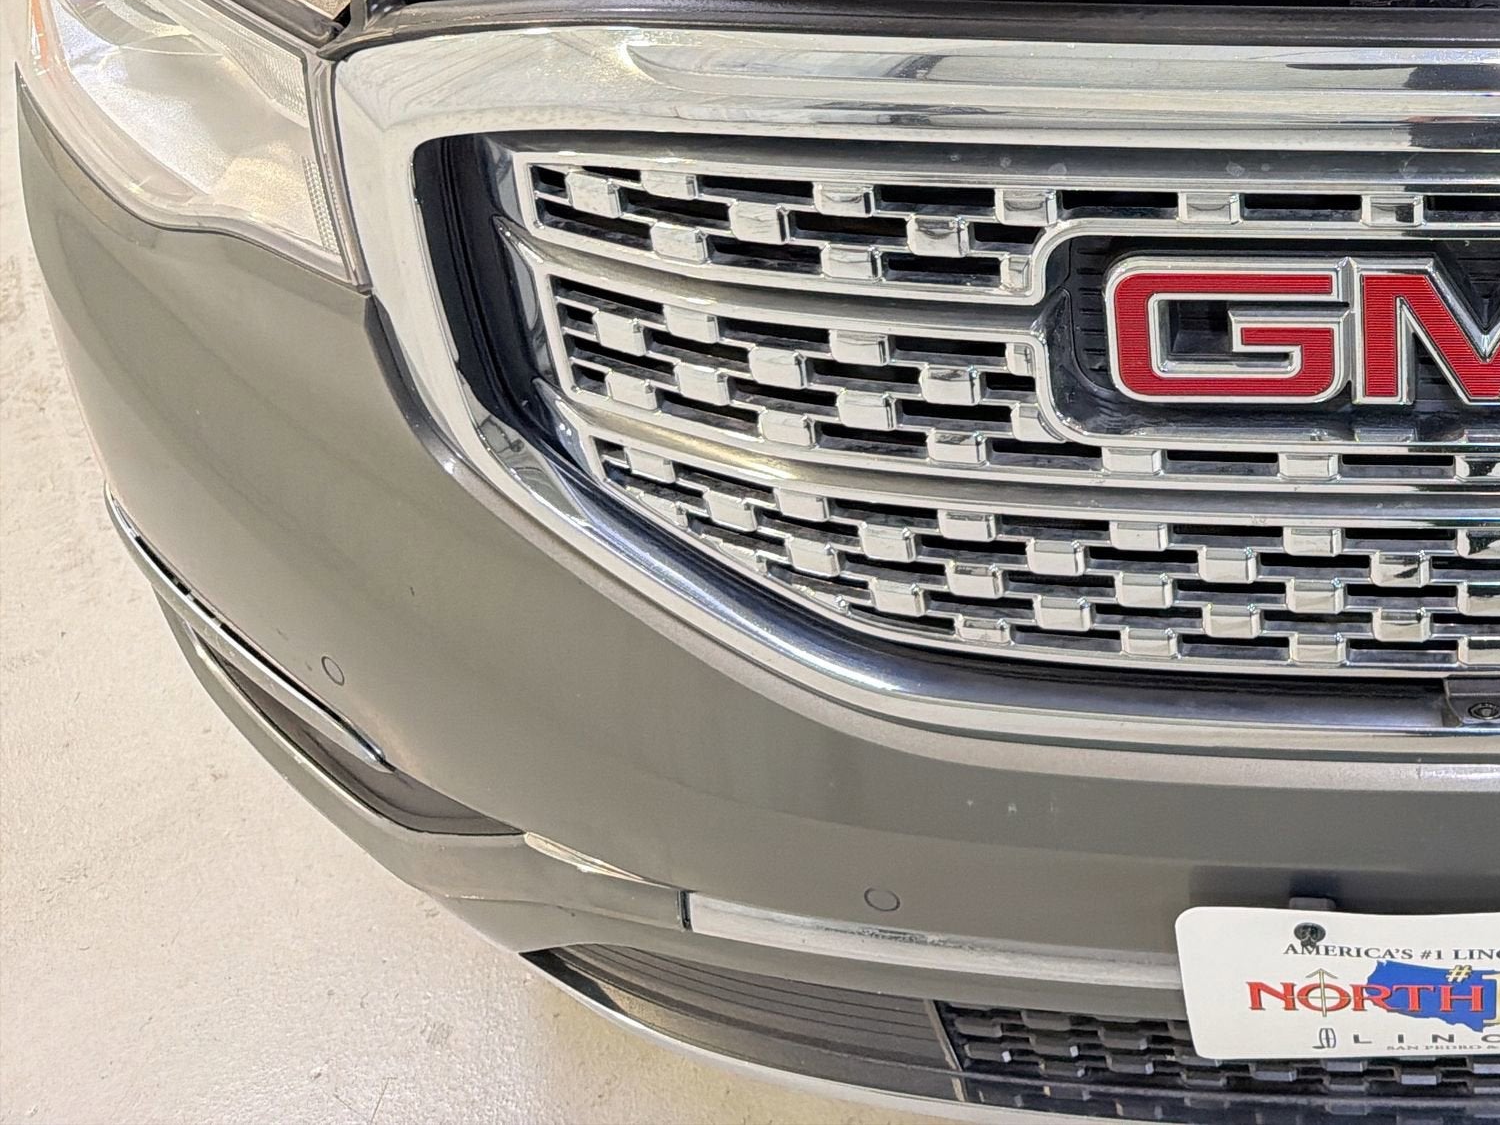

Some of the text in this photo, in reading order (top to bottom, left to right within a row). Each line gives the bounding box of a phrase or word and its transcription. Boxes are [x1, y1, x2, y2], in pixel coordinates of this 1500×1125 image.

[1283, 943, 1413, 960] AMERICA'S
[1419, 948, 1444, 960] #1
[1245, 980, 1485, 1012] NORTH
